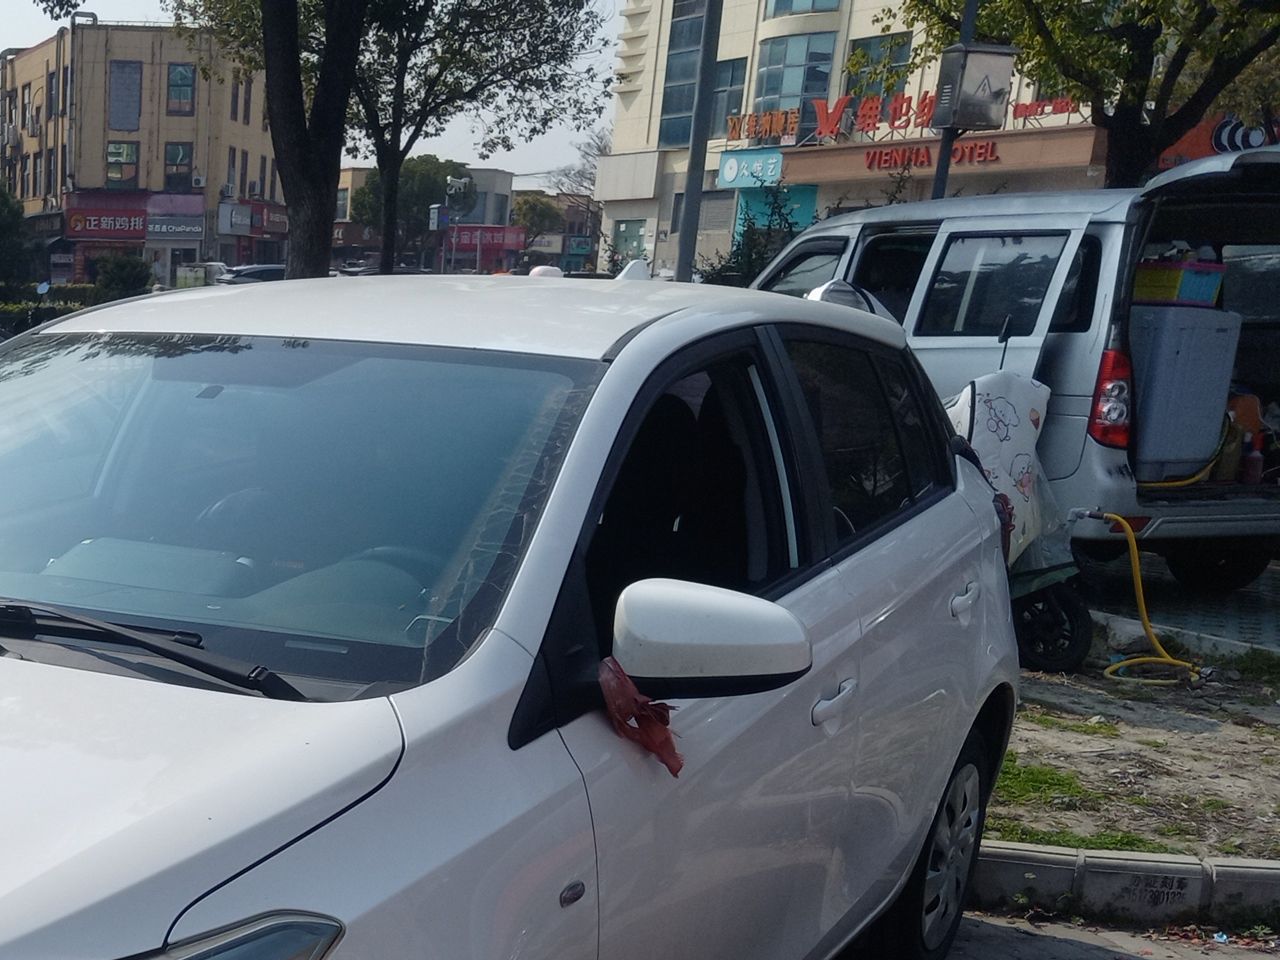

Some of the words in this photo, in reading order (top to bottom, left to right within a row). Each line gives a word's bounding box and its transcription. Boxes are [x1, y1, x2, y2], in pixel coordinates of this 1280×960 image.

[951, 141, 999, 163] OTEL
[86, 216, 144, 231] 正新鸡排
